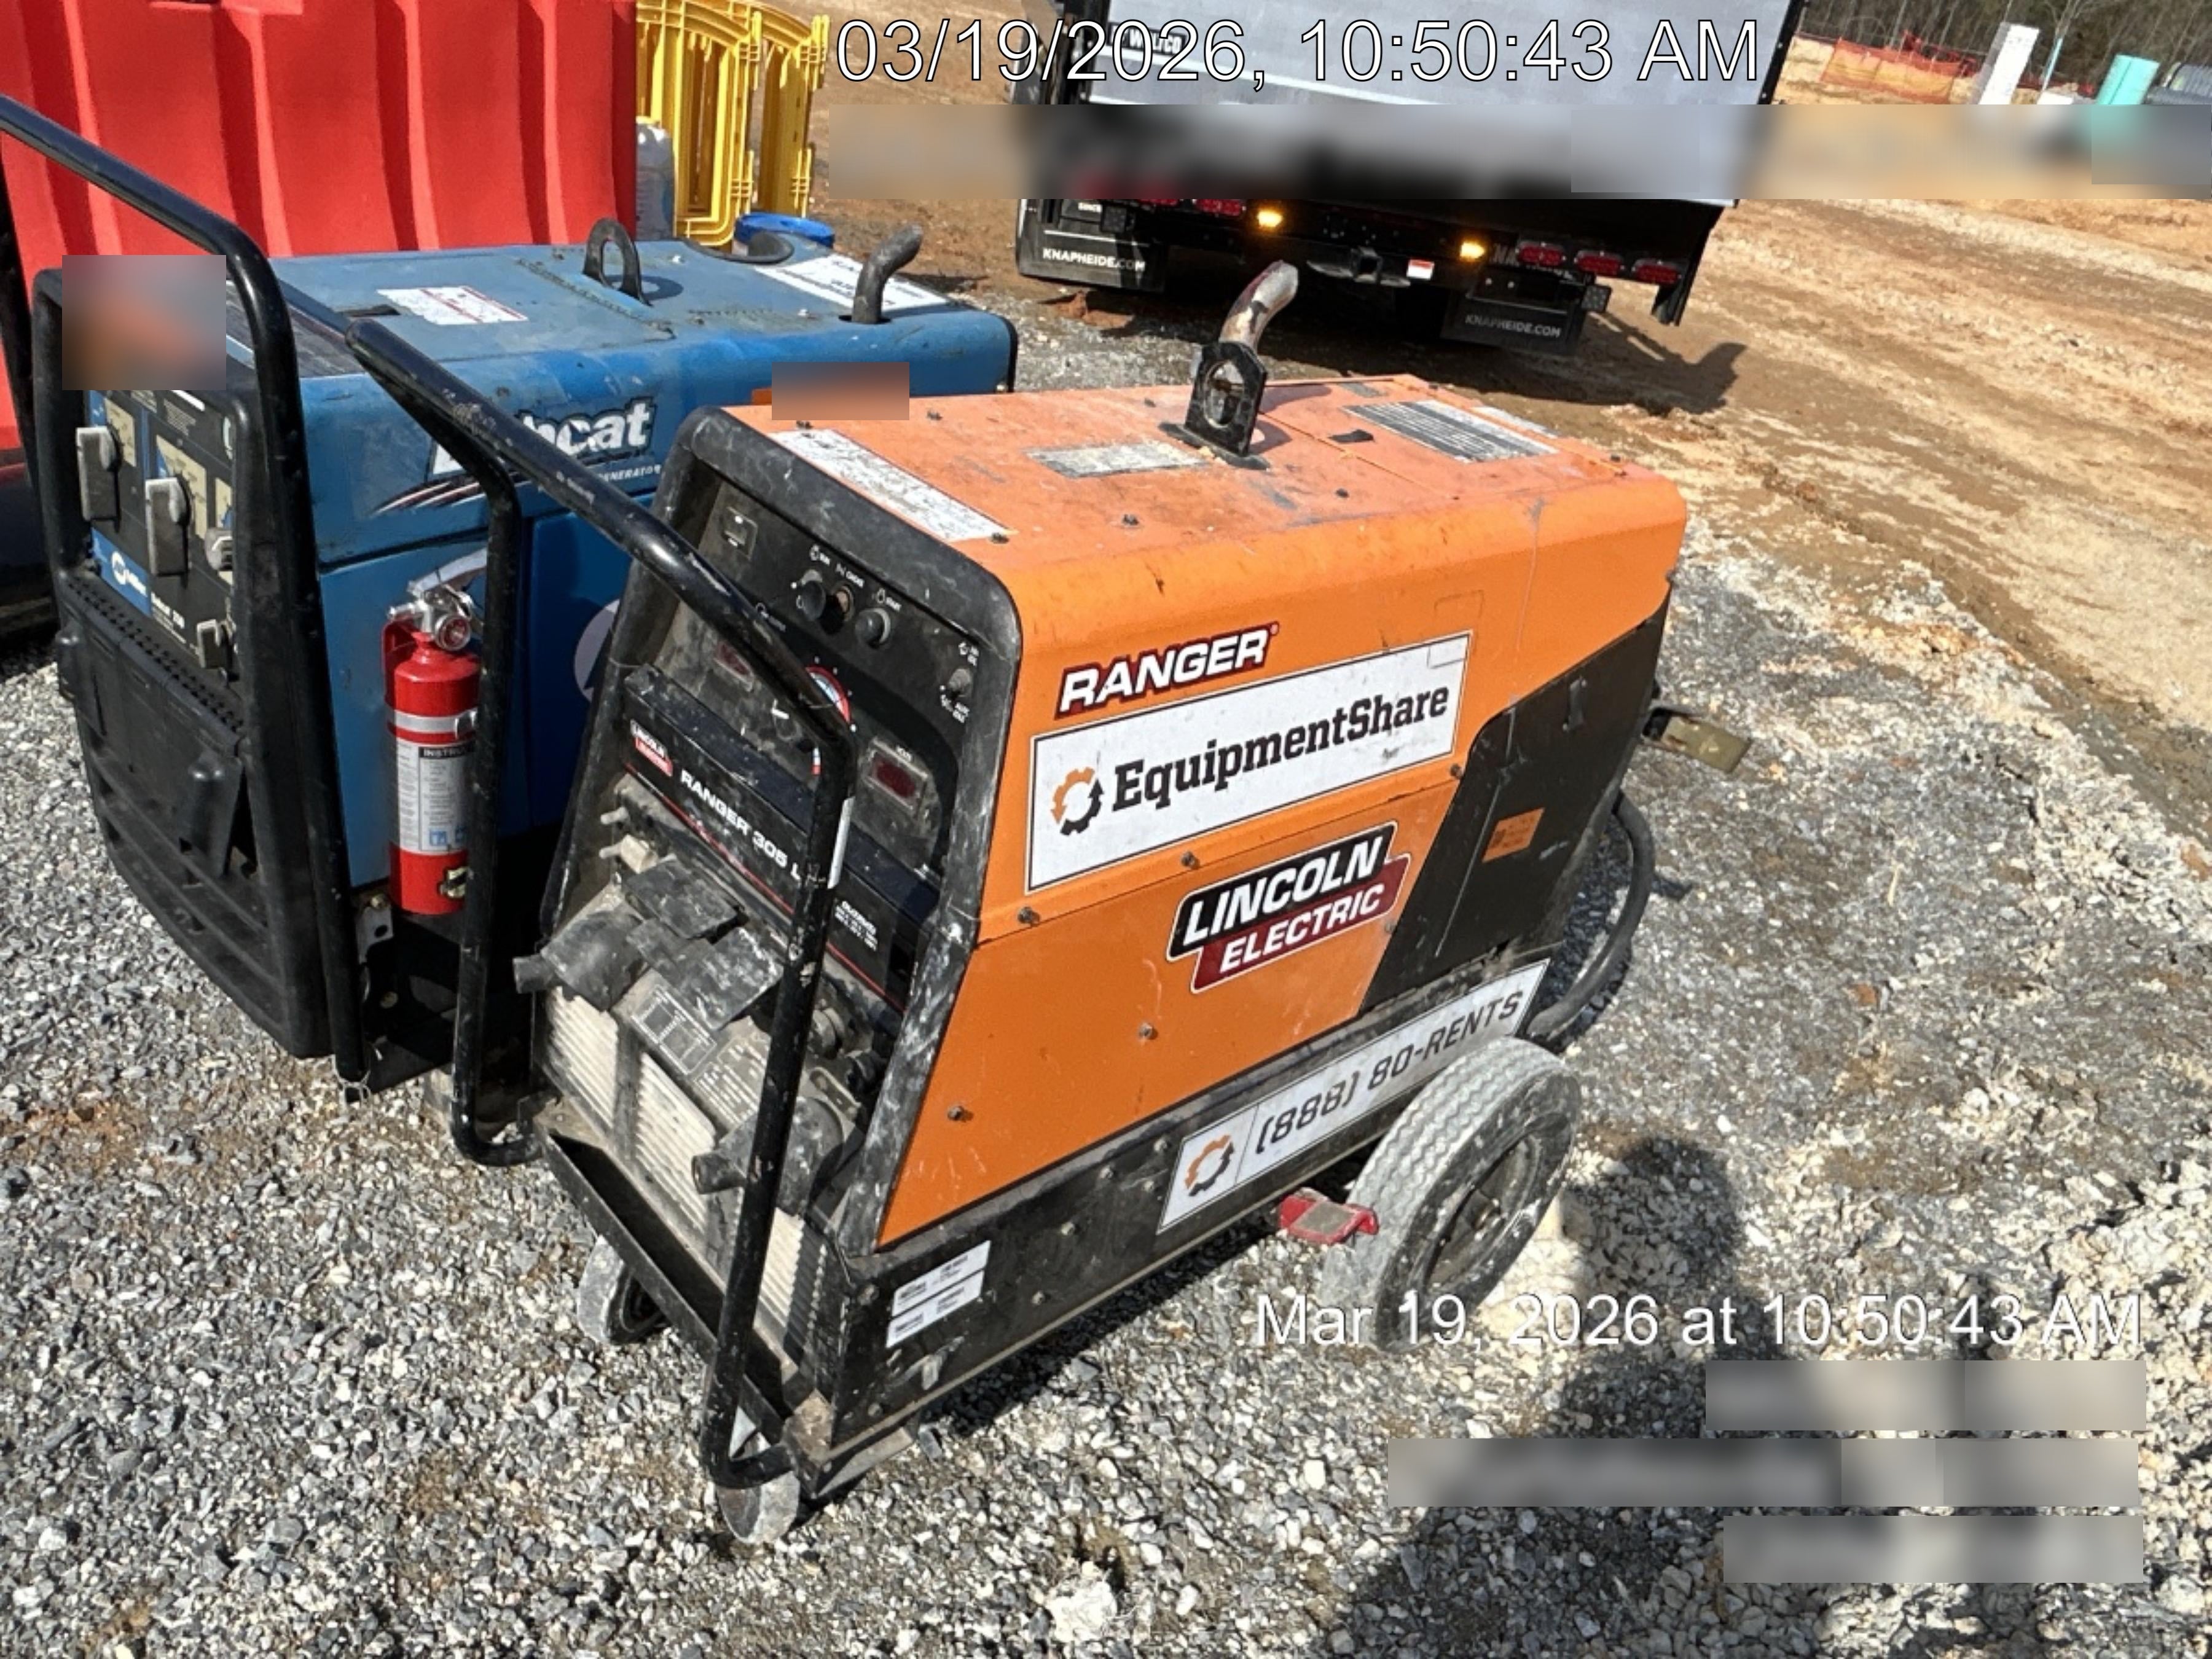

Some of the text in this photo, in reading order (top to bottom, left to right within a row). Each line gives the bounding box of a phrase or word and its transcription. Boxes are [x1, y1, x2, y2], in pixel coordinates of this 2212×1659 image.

[1042, 248, 1146, 272] KNAPHEIDE.COM
[1465, 314, 1561, 337] KNAPHEIDE.COM
[1059, 629, 1269, 713] RANGER
[1110, 686, 1449, 812] EquipmentShare
[680, 768, 751, 836] RANGER
[751, 830, 788, 869] 305
[1182, 836, 1384, 946] LINCOLN
[1219, 883, 1386, 974] ELECTRIC
[1255, 990, 1524, 1155] (888) 80-RENTS
